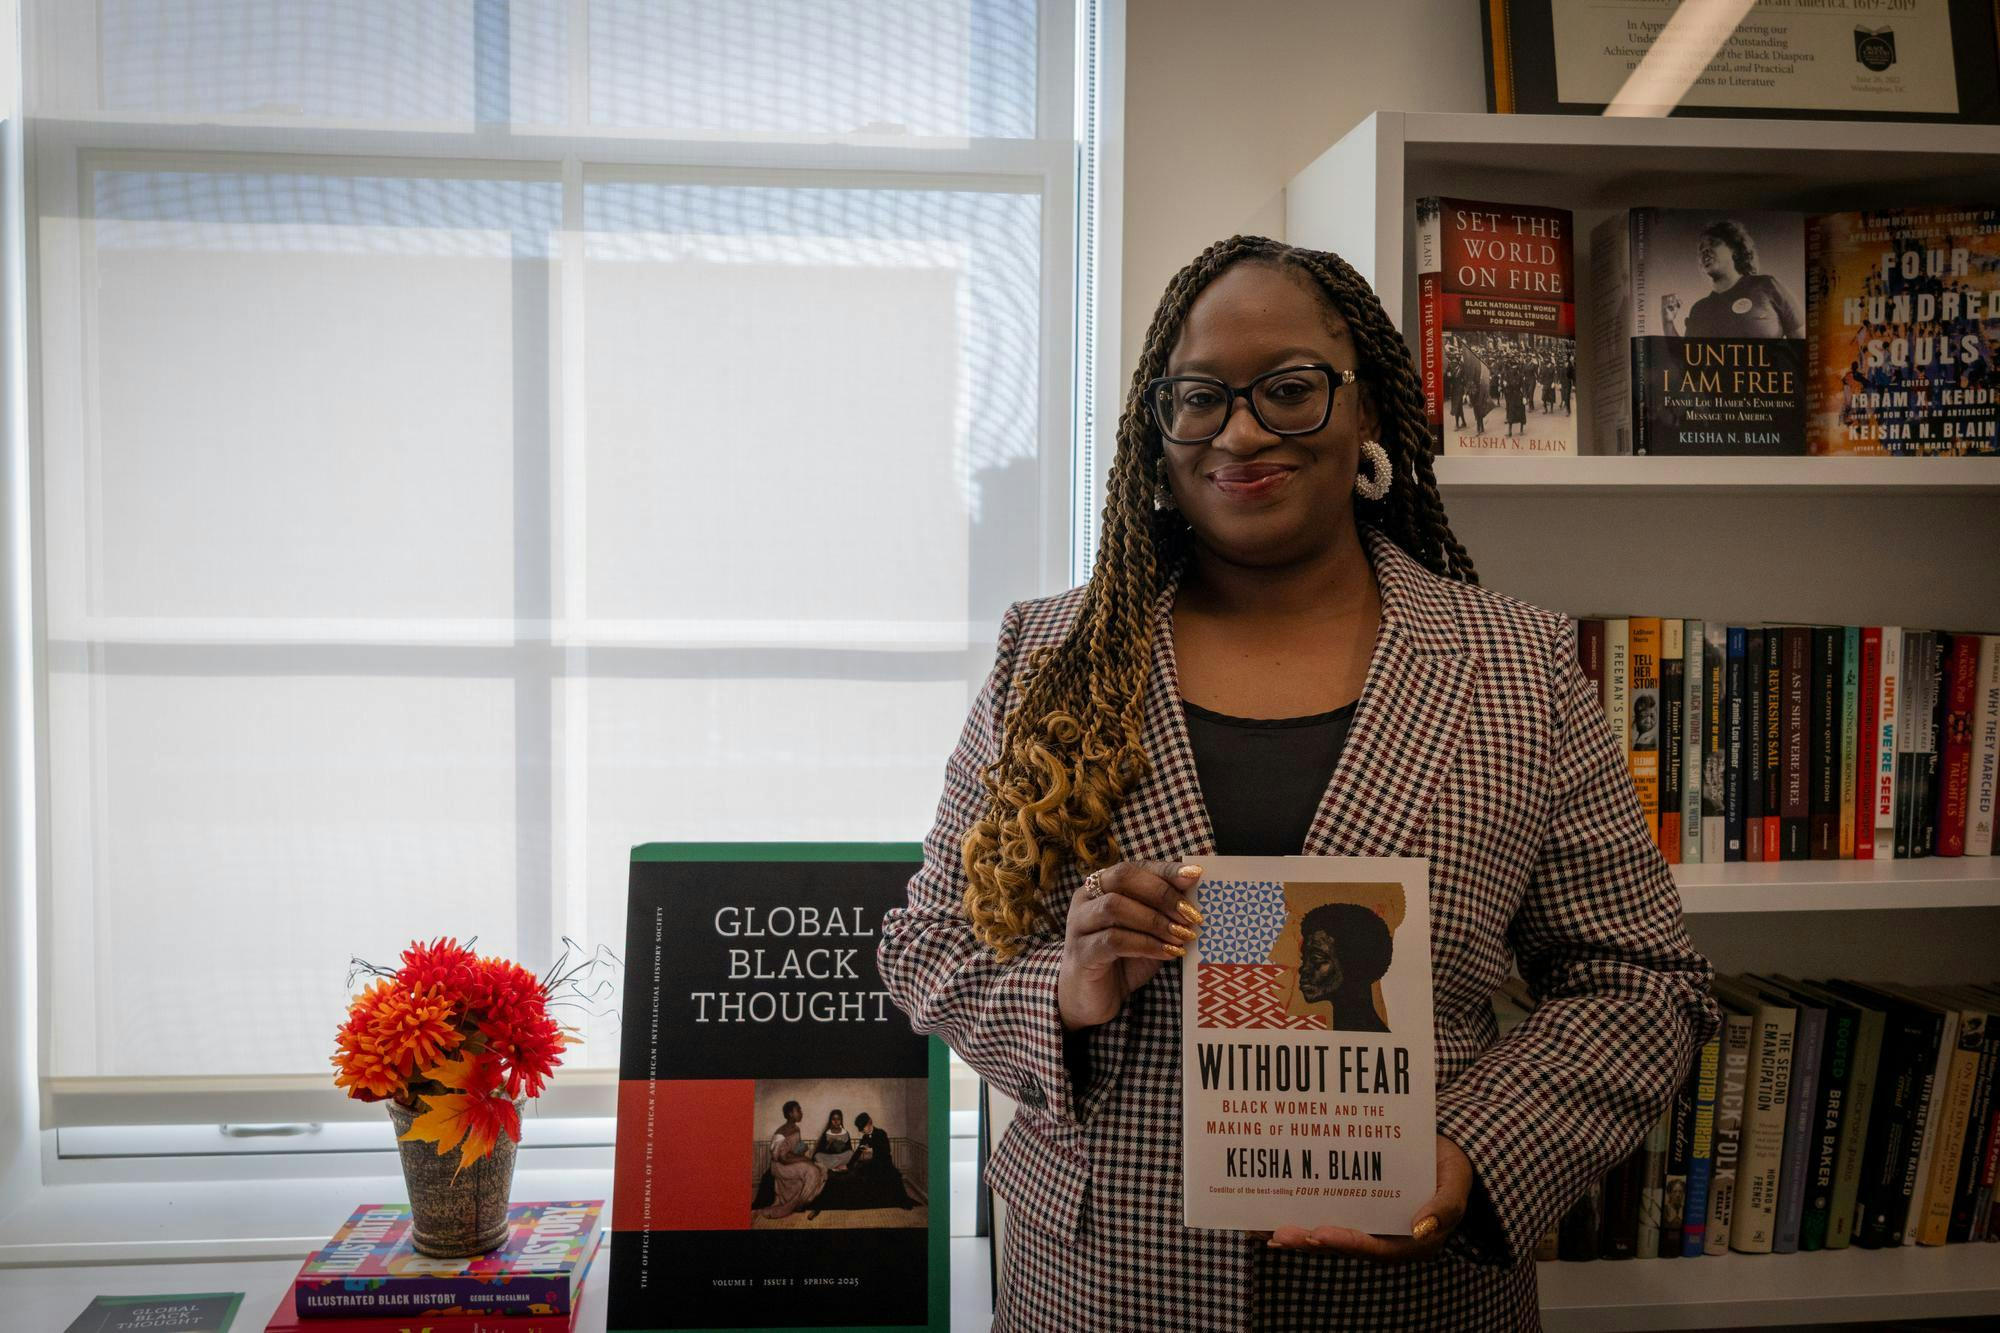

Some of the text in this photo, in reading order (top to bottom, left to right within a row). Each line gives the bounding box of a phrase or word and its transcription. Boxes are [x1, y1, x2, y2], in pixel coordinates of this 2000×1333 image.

[1727, 50, 1742, 60] the
[1745, 50, 1770, 61] Black
[1773, 52, 1815, 64] Diaspora
[1730, 37, 1788, 49] Outstanding
[1729, 76, 1775, 87] Literature
[1754, 63, 1794, 74] Practical
[1456, 211, 1561, 240] SET THE
[1464, 239, 1555, 265] WORLD
[1881, 248, 1970, 281] FOUR
[1458, 266, 1562, 293] ON FIRE
[1465, 300, 1556, 313] BLACK NATIONALIST WOMEN
[1498, 310, 1522, 318] GLOBAL
[1525, 312, 1555, 321] STRUGGLE
[1843, 290, 2000, 326] HUNDRED
[1505, 319, 1534, 327] FREEDOM
[1424, 279, 1436, 416] SET THE WORLD ON FIRE
[1685, 344, 1770, 367] UNTIL
[1868, 335, 1979, 368] SOULS
[1663, 370, 1794, 394] I AM FREE
[1851, 389, 1995, 409] IBRAM X. KENDI
[1459, 436, 1566, 451] KEISHA N. BLAIN
[1679, 432, 1780, 444] KEISHA N. BLAIN
[1849, 422, 1996, 441] KEISHA N. BLAIN
[1633, 654, 1653, 666] TELL
[1633, 666, 1651, 678] HER
[1614, 645, 1624, 712] FREEMAN'S
[1633, 678, 1658, 690] STORY
[1792, 673, 1800, 688] AS
[1690, 685, 1700, 711] BLACK
[1732, 698, 1742, 724] Fannie
[1768, 669, 1779, 738] REVERSING
[1792, 691, 1800, 703] IF
[1884, 676, 1895, 720] UNTIL
[1690, 714, 1699, 744] WOMEN
[1791, 705, 1800, 729] SHE
[1671, 701, 1681, 792] Fannie Lou Hamer
[1732, 726, 1741, 739] Lou
[1731, 741, 1741, 768] Hamer
[1767, 740, 1779, 768] SAIL
[1790, 733, 1800, 771] WERE
[1882, 725, 1893, 772] WE'RE
[1979, 688, 1999, 813] WHY THEY MARCHED
[1689, 768, 1698, 789] SAVE
[1790, 773, 1800, 806] FREE
[1947, 762, 1960, 816] TAUGHT US
[1957, 752, 1969, 826] BLACK WOMEN
[1689, 791, 1698, 806] THE
[1881, 777, 1891, 815] SEEN
[1688, 808, 1698, 837] WORLD
[714, 906, 874, 937] GLOBAL
[654, 944, 662, 982] HISTORY
[728, 949, 859, 979] BLACK
[691, 991, 890, 1023] THOUGHT
[1832, 1017, 1850, 1079] ROOTED
[649, 1048, 657, 1096] AMERICAN
[1198, 1044, 1409, 1094] WITHOUT FEAR
[1757, 1024, 1778, 1111] EMANCIPATION
[1773, 1032, 1791, 1104] THE SECOND
[1721, 1054, 1748, 1122] BLACK
[647, 1099, 655, 1138] AFRICAN
[1222, 1100, 1385, 1117] BLACK WOMEN AND THE
[1207, 1121, 1401, 1139] MAKING OF HUMAN RIGHTS
[1817, 1089, 1841, 1186] BREA BAKER
[1902, 1075, 1934, 1195] WITH HER FIST RAISED
[1942, 1062, 1974, 1194] ON HER OWN GROUND
[1227, 1148, 1382, 1181] KEISHA N. BLAIN
[1714, 1128, 1739, 1179] FOLK
[646, 1163, 652, 1175] OF
[644, 1177, 652, 1219] JOURNAL
[1209, 1186, 1235, 1194] Coeditor
[1237, 1186, 1244, 1194] of
[1257, 1187, 1293, 1196] best-selling
[1296, 1187, 1319, 1196] FOUR
[1323, 1188, 1367, 1197] HUNDRED
[1371, 1189, 1401, 1198] SOULS
[1751, 1176, 1763, 1208] FRENCH
[1763, 1169, 1775, 1216] HOWARD W.
[511, 1207, 589, 1271] HISTORY
[642, 1222, 650, 1266] OFFICIAL
[640, 1269, 648, 1288] THE
[837, 1278, 859, 1286] 2025
[132, 1305, 201, 1315] GLOBAL
[307, 1293, 456, 1307] ILLUSTRATED BLACK HISTORY
[470, 1294, 494, 1302] GEORGE
[116, 1316, 204, 1329] THOUGHT
[135, 1312, 190, 1322] BLACK
